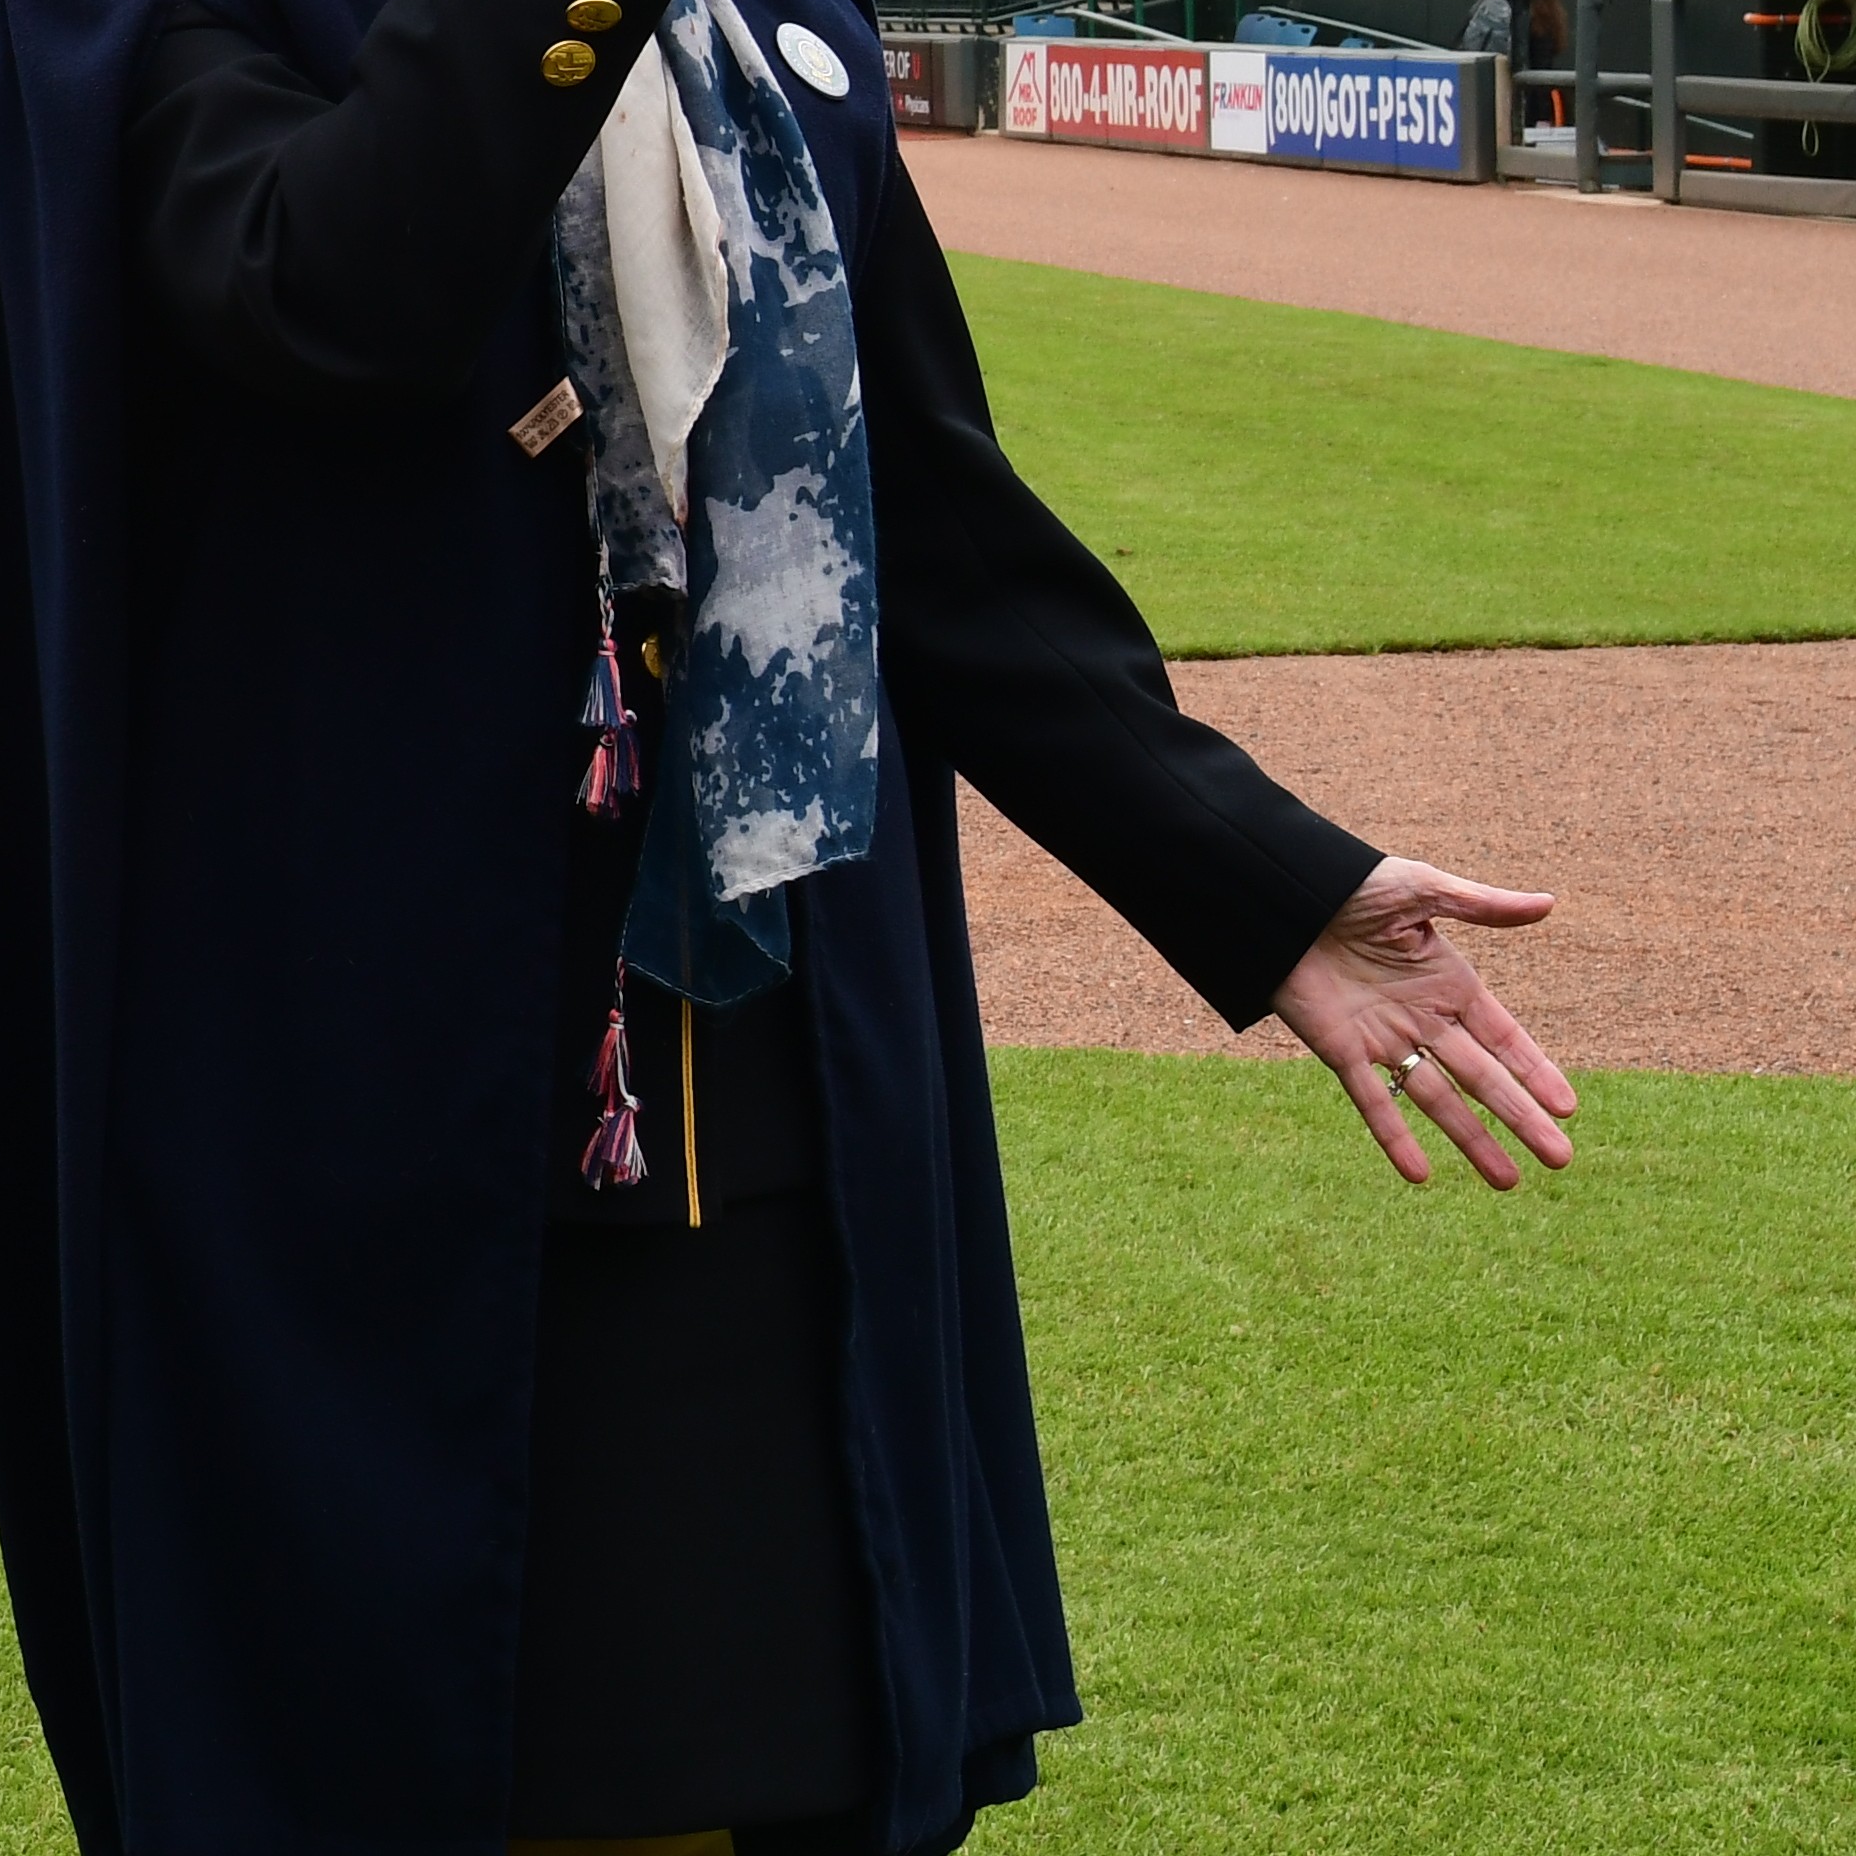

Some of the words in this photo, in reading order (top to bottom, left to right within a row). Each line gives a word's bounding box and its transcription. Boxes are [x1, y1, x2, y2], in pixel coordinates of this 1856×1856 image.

[897, 51, 911, 80] OF
[1050, 62, 1202, 133] 800-4-MR-ROOF
[1213, 82, 1264, 118] FRANKLIN
[1267, 64, 1455, 152] (800)GOT-PESTS
[1013, 107, 1038, 126] ROOF
